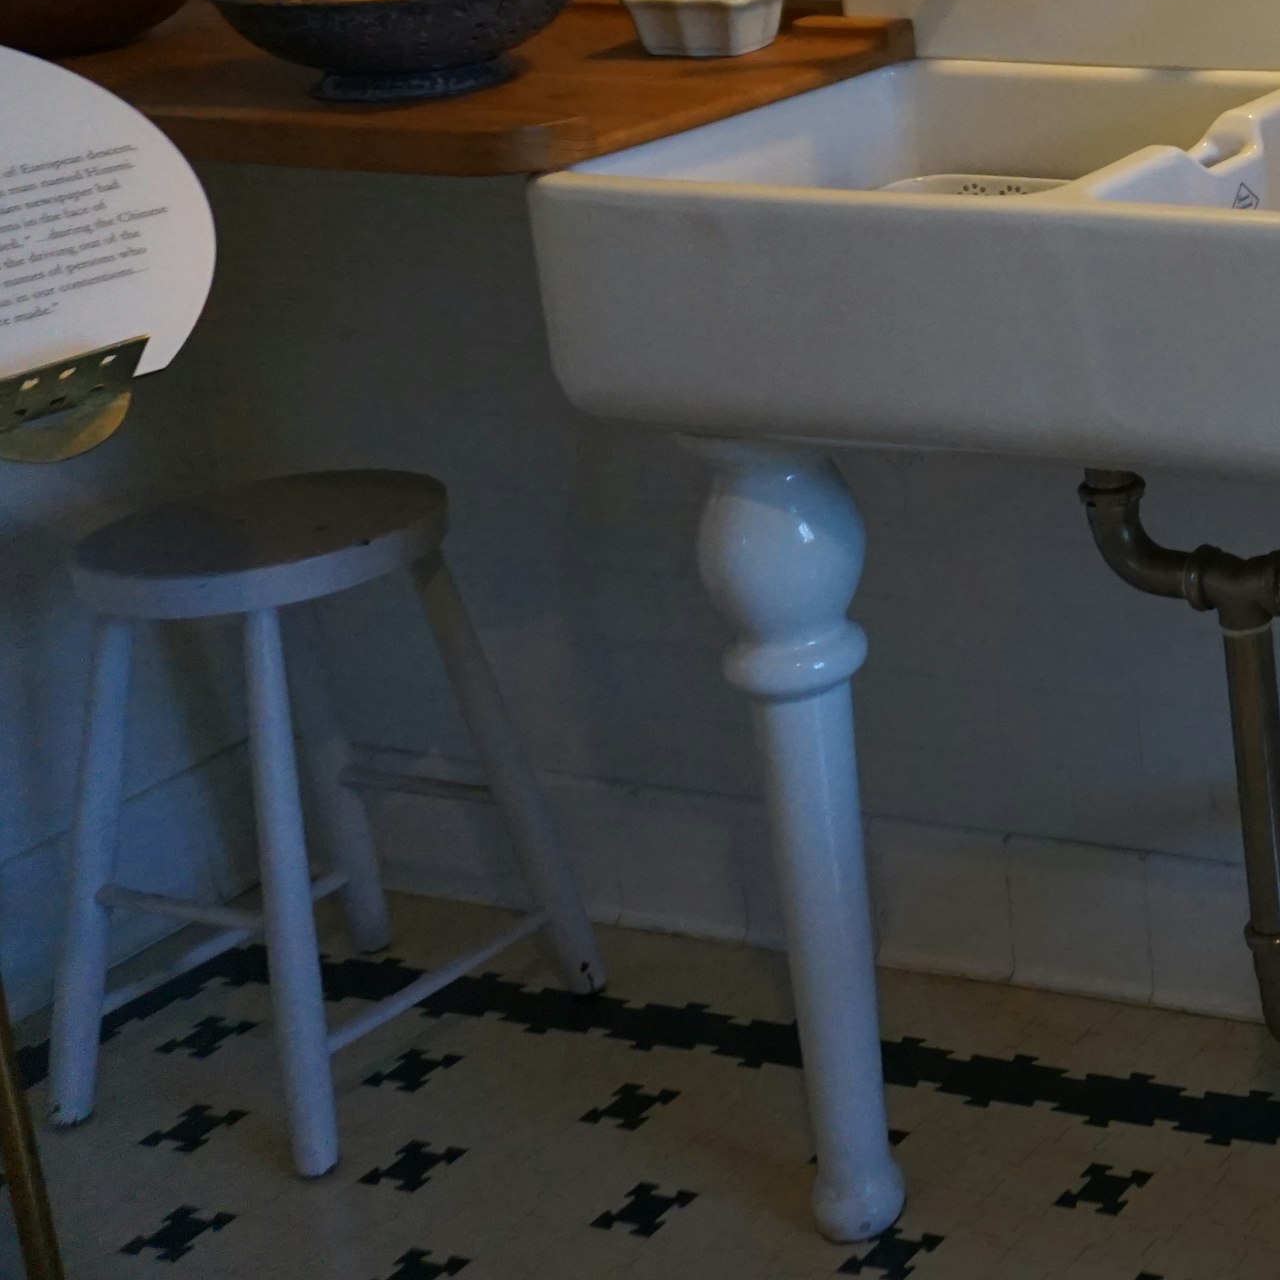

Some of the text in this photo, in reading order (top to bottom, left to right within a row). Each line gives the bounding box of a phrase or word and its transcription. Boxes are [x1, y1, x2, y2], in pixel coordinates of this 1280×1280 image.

[20, 156, 83, 173] European
[7, 183, 38, 194] man
[40, 170, 83, 187] named
[24, 188, 93, 209] newspaper
[94, 178, 120, 193] had
[39, 213, 62, 223] the
[91, 199, 107, 211] of
[94, 218, 115, 228] the
[117, 206, 169, 222] Chinese
[3, 230, 141, 268] the driving out of the
[3, 247, 147, 288] names of persons who
[15, 295, 30, 303] in
[32, 287, 55, 299] our
